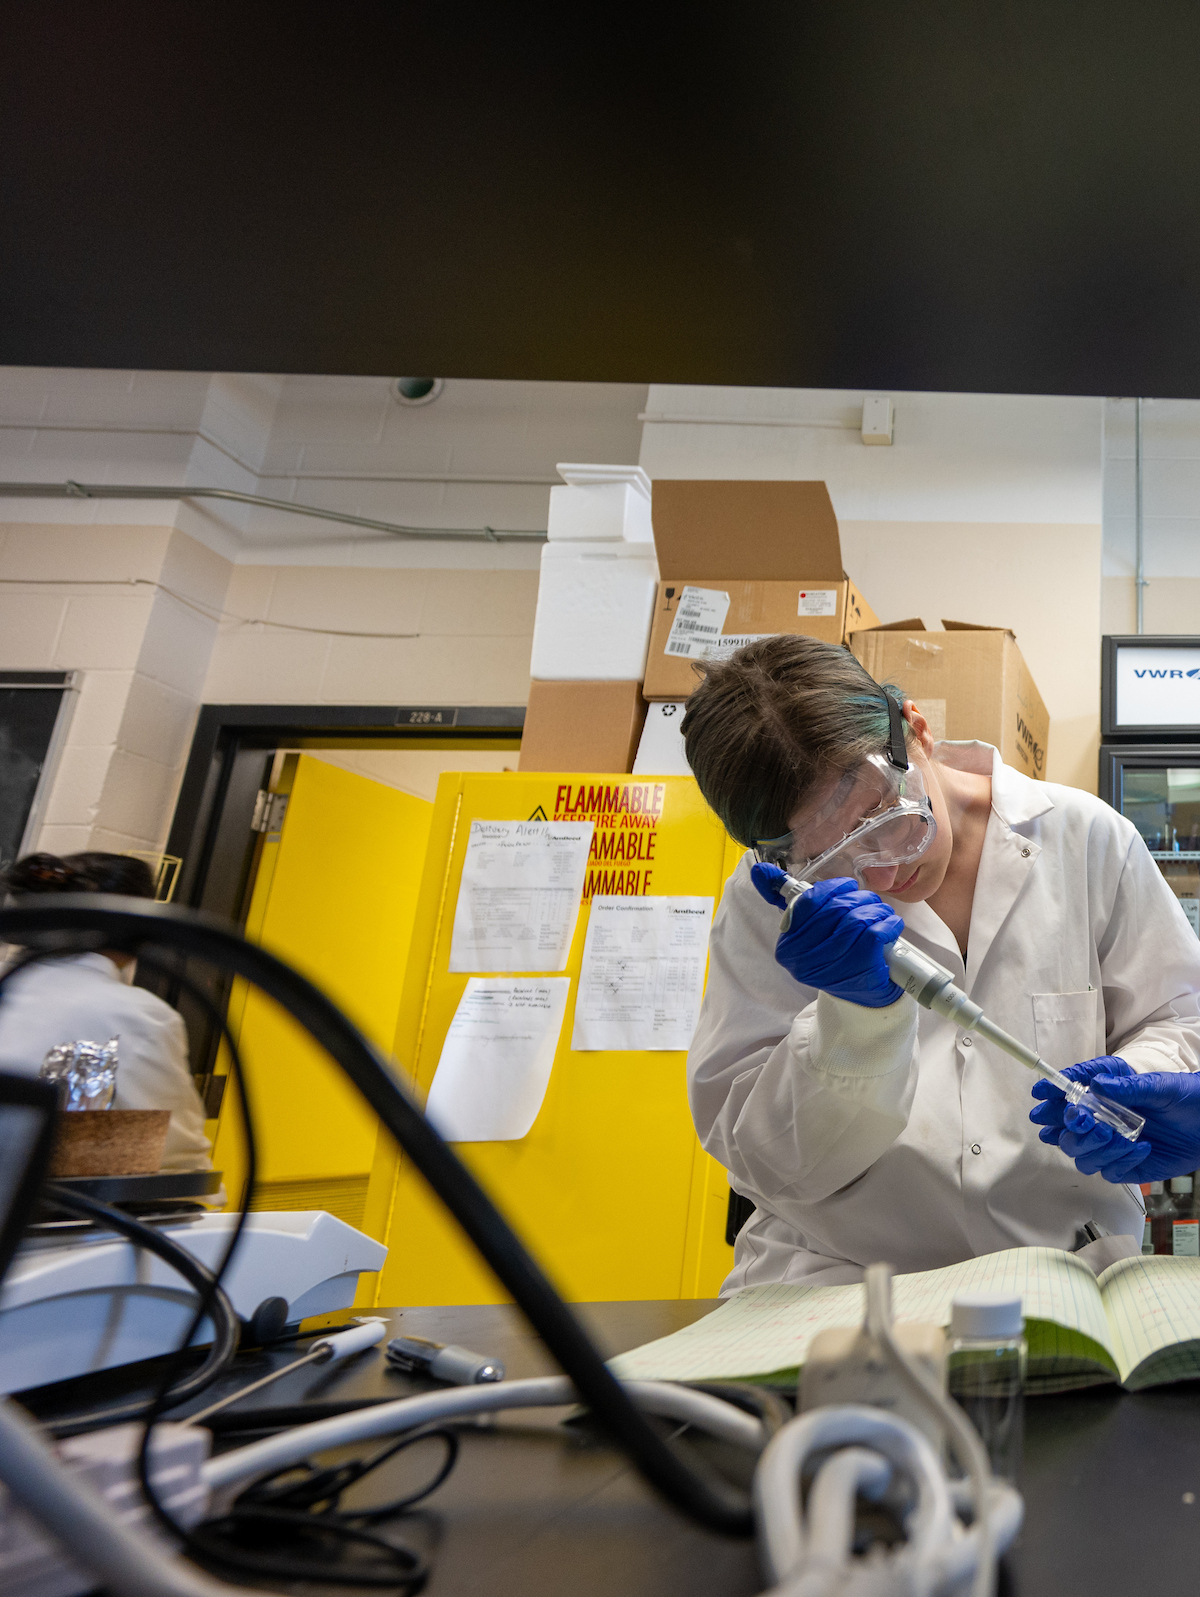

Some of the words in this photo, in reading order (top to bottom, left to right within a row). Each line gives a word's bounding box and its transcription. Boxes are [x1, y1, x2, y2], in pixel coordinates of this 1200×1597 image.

[1134, 669, 1183, 679] VWR
[409, 711, 443, 723] 228-A
[1016, 712, 1033, 753] VWR
[554, 785, 663, 813] FLAMMABLE
[471, 822, 510, 838] Delivery
[589, 814, 618, 829] FIRE
[619, 815, 659, 829] AWAY
[588, 832, 657, 860] AMABLE
[582, 870, 653, 898] MMABLE
